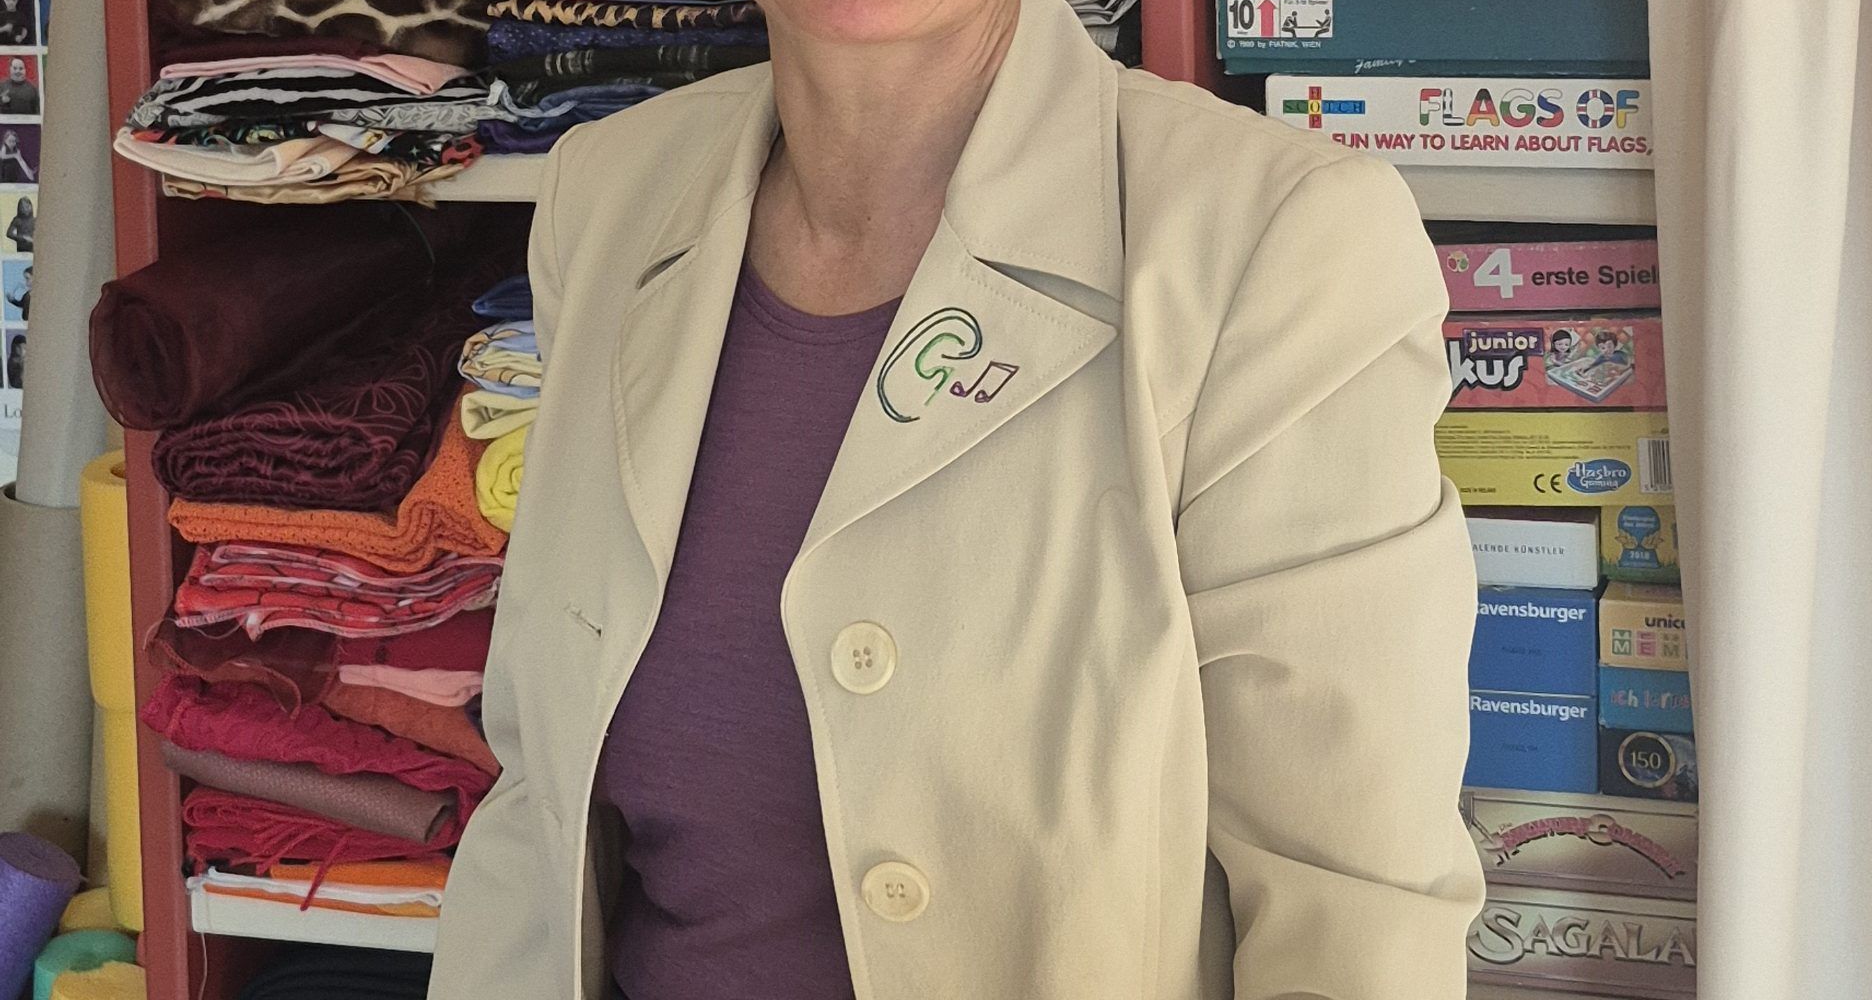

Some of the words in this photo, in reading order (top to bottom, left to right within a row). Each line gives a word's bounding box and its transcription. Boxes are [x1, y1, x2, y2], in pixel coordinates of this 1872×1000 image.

[1419, 87, 1564, 128] FLAGS
[1575, 88, 1640, 128] OF
[1375, 133, 1415, 150] WAY
[1418, 133, 1446, 150] TO
[1451, 134, 1510, 152] LEARN
[1514, 135, 1582, 152] ABOUT
[1587, 136, 1654, 155] FLAGS,
[1473, 248, 1523, 299] 4
[1531, 265, 1590, 286] erste
[1598, 264, 1657, 289] Spiel
[1468, 331, 1538, 352] junior
[1568, 462, 1627, 479] Hasbro
[1514, 544, 1565, 556] KÜNSTLER
[1477, 601, 1587, 622] avensburger
[1470, 695, 1588, 721] Ravensburger
[1630, 751, 1661, 769] 150
[1466, 906, 1696, 965] SAGALA
